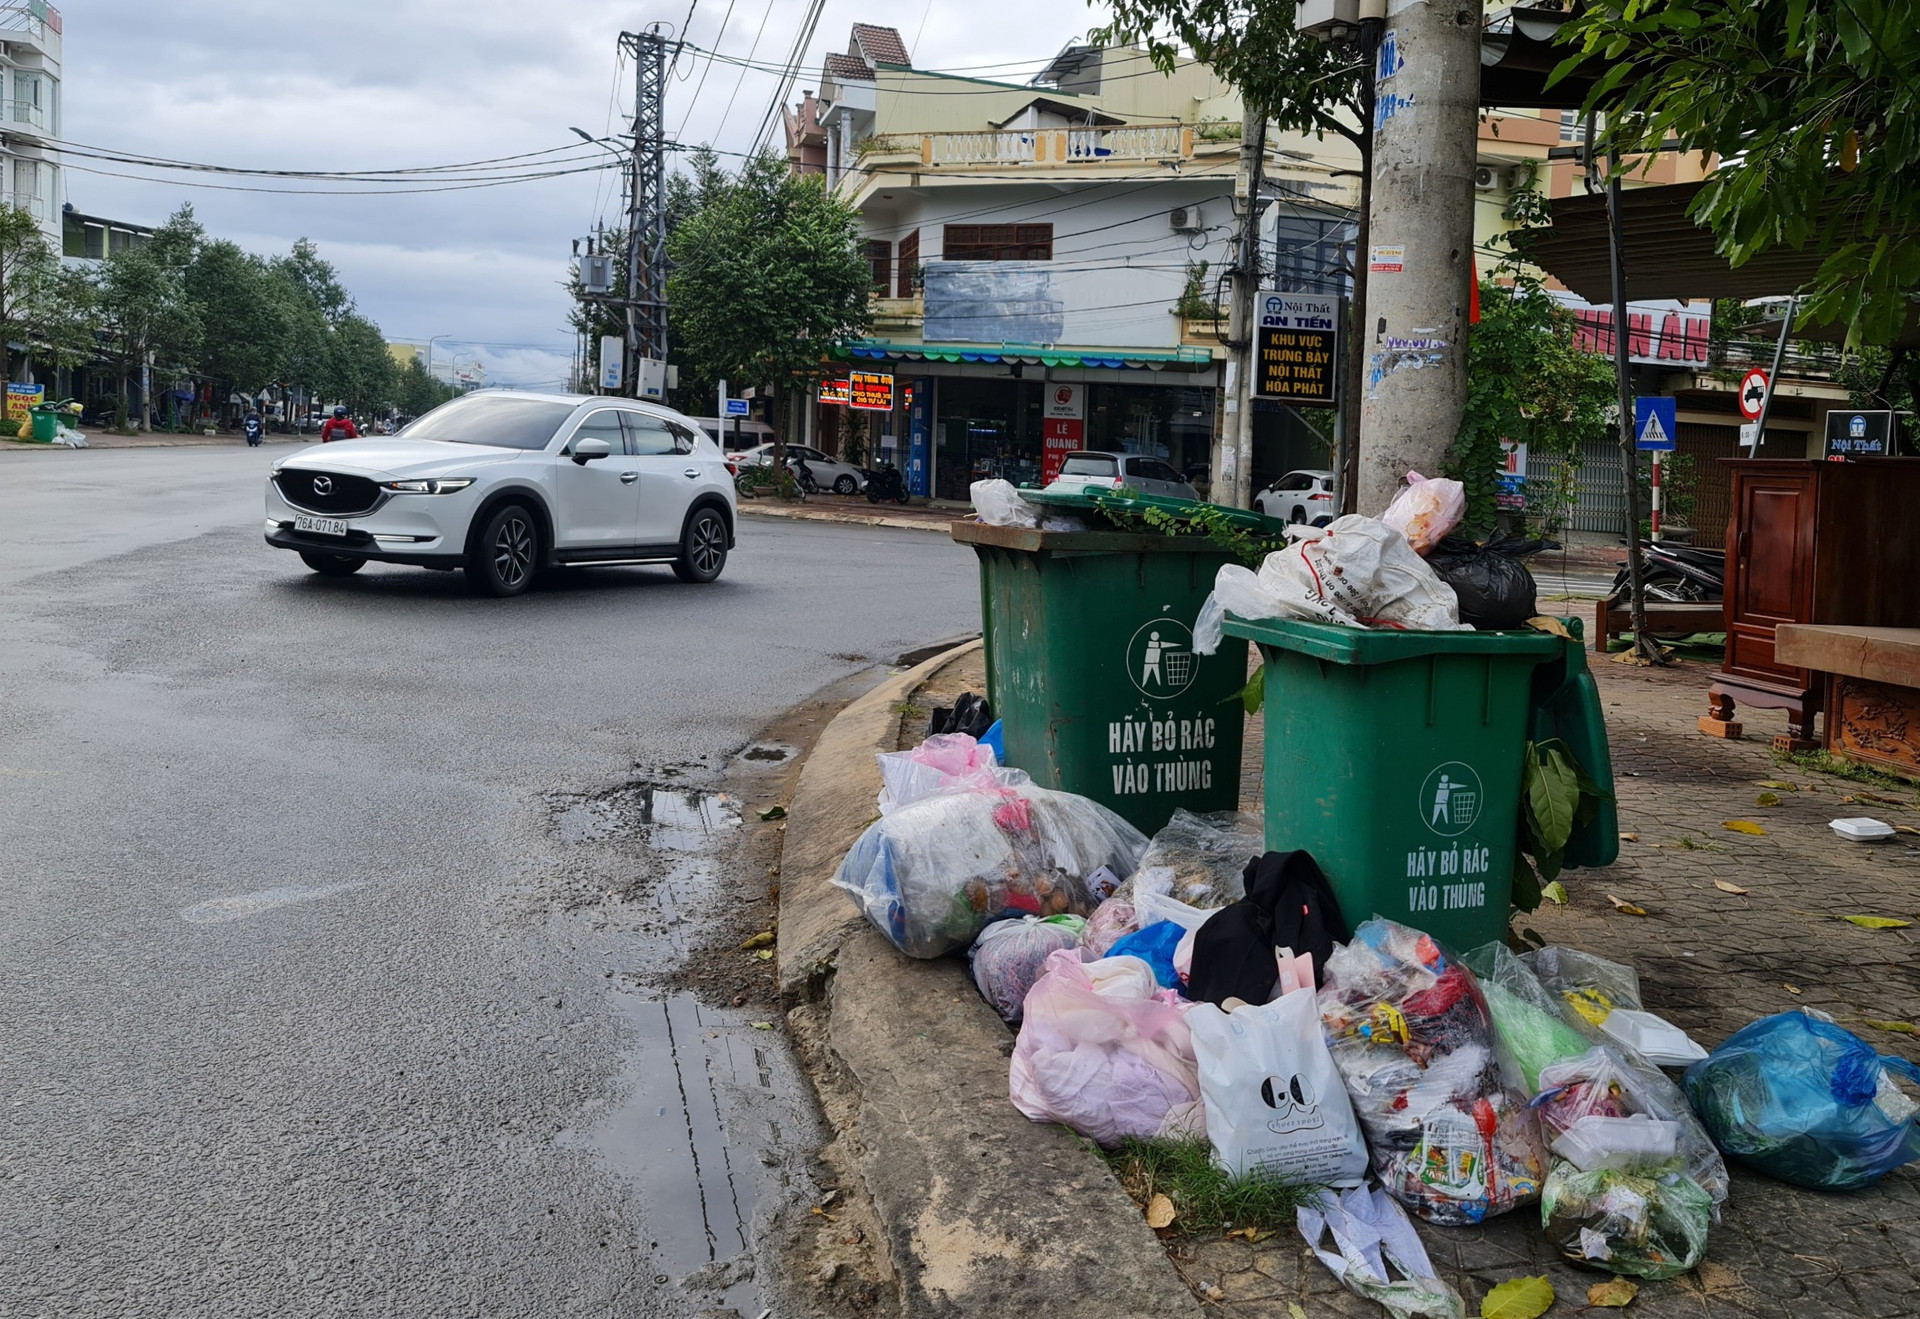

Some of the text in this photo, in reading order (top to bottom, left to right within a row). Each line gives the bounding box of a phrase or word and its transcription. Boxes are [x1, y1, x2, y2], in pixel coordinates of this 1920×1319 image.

[1284, 302, 1302, 313] Nội
[1306, 303, 1330, 313] Thất
[1263, 315, 1332, 329] AN TIẾN
[1271, 334, 1322, 350] KHU VỰC
[1263, 348, 1302, 362] TRƯNG
[1269, 362, 1322, 379] NỘI THẤT
[1266, 378, 1324, 394] HÒA PHÁT
[1057, 422, 1068, 434] LÊ
[1046, 438, 1078, 449] QUANG
[1831, 439, 1882, 452] Nội Thất
[298, 517, 344, 534] 76A-071.84
[1109, 711, 1215, 753] HÃY BỎ RÁC
[1112, 754, 1211, 794] VÀO THÙNG
[1407, 841, 1489, 877] HÃY BỎ RÁC
[1409, 878, 1485, 912] VÀO THÙNG
